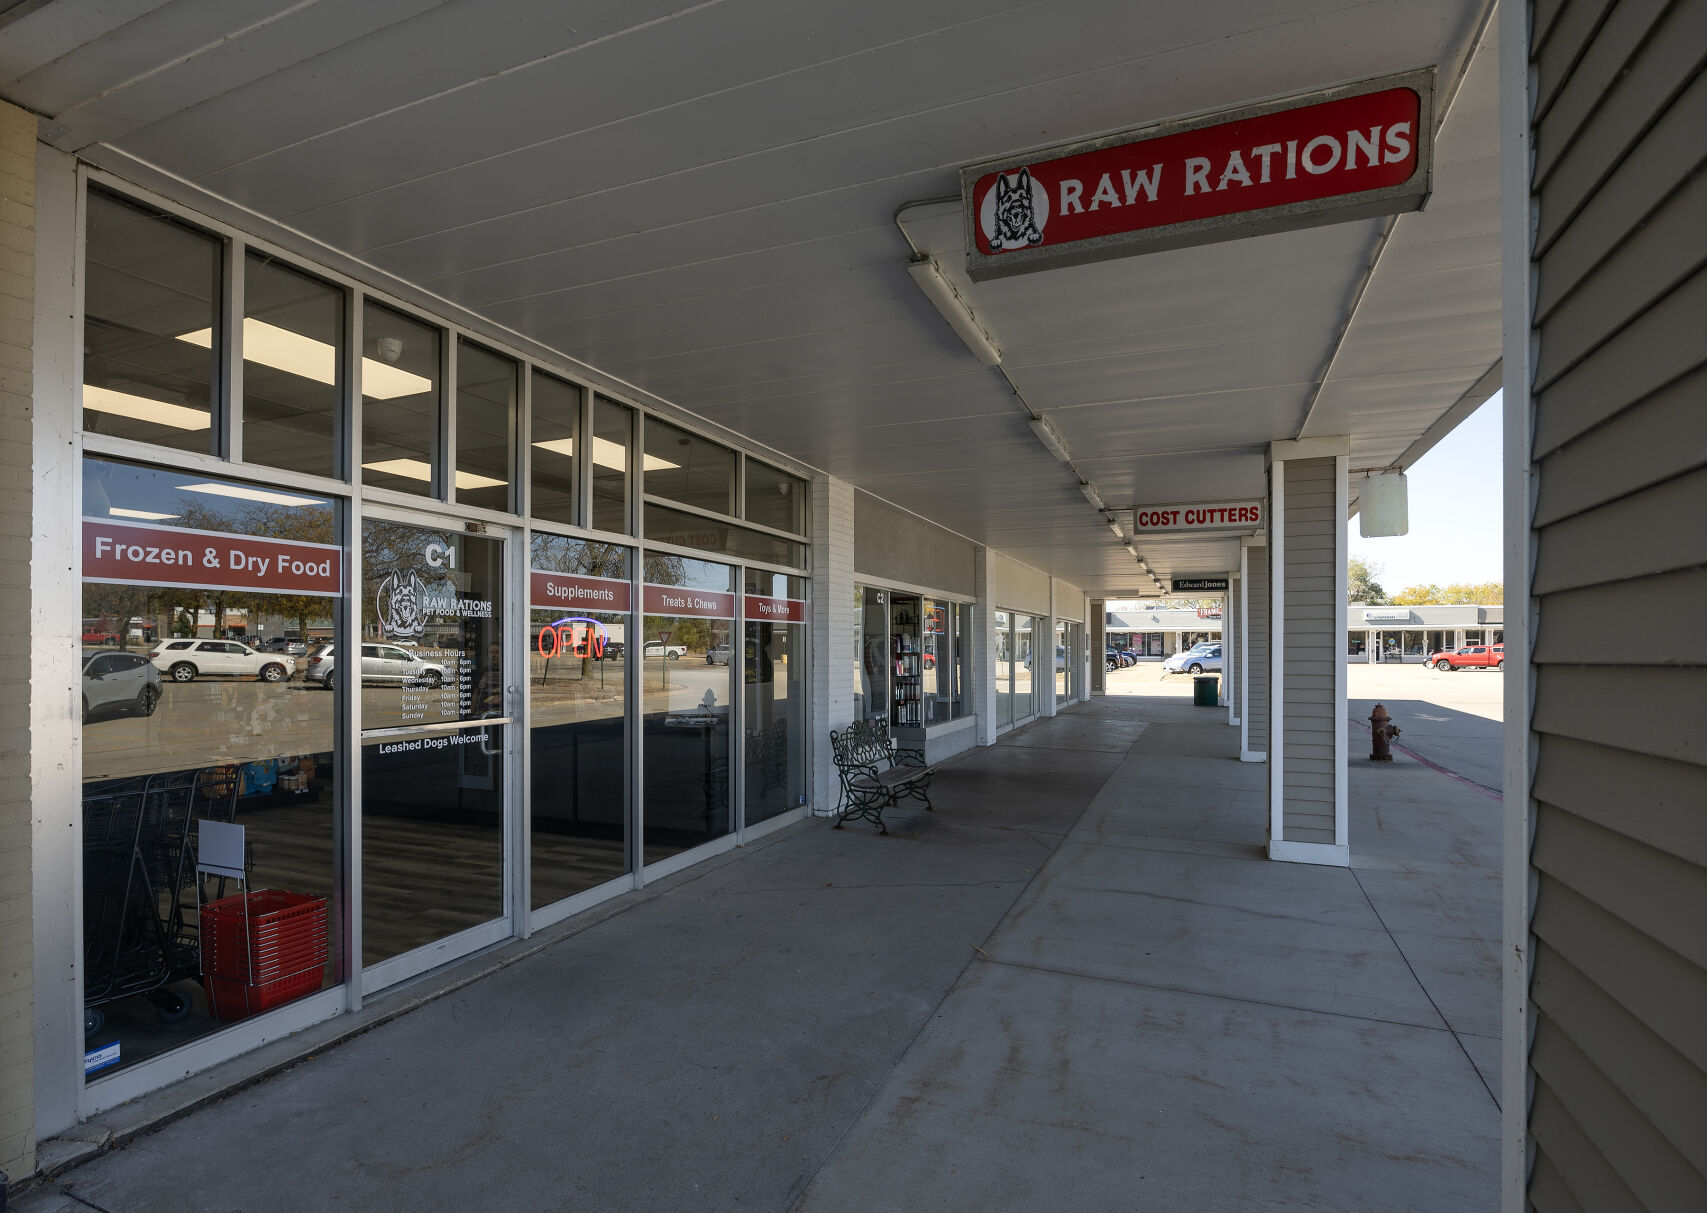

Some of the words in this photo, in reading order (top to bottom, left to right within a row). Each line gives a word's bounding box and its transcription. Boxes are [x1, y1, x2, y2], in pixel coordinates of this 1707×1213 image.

[1058, 164, 1164, 216] RAW
[1184, 120, 1412, 196] RATIONS
[1138, 510, 1180, 527] COST
[1184, 506, 1259, 525] CUTTERS
[95, 537, 193, 566] Frozen
[202, 548, 221, 568] &
[229, 550, 271, 577] Dry
[277, 554, 331, 578] Food
[425, 543, 456, 569] C1
[546, 582, 614, 601] Supplements
[876, 592, 885, 604] C2
[422, 596, 447, 608] RAW
[451, 598, 492, 611] RATIONS
[661, 594, 686, 609] Treats
[687, 598, 694, 609] &
[694, 598, 717, 610] Chews
[758, 602, 771, 614] Toys
[772, 604, 777, 613] &
[777, 603, 790, 615] More
[436, 608, 454, 616] FOOD
[461, 609, 492, 618] WELLNESS
[538, 625, 605, 659] OPEN
[409, 649, 442, 657] Business
[444, 649, 466, 657] Hours
[402, 694, 421, 702] Friday
[402, 703, 428, 711] Saturday
[402, 712, 424, 720] Sunday
[379, 739, 422, 754] Leashed
[424, 737, 448, 752] Dogs
[449, 733, 489, 745] Welcome
